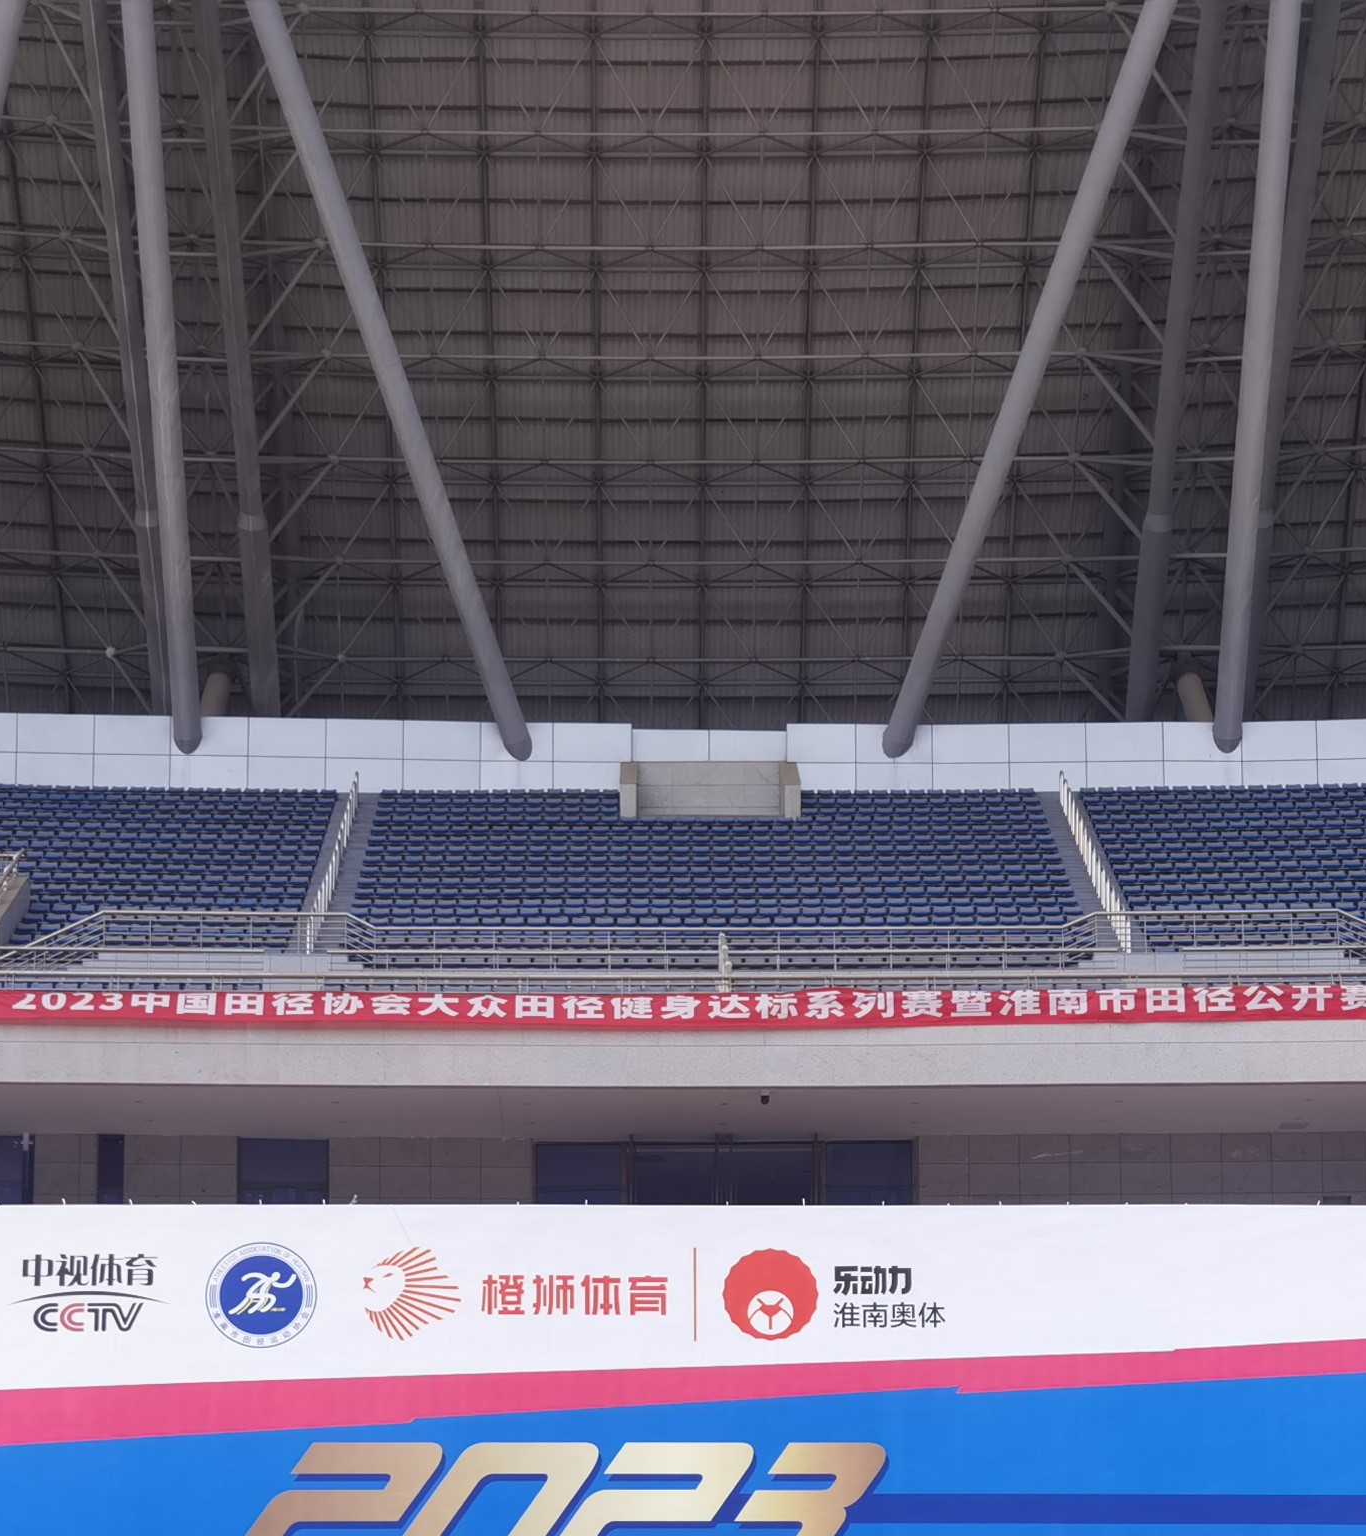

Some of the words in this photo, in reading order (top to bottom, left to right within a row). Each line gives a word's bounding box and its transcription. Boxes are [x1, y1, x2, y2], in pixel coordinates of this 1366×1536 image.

[21, 1253, 159, 1287] 中视体育
[480, 1273, 669, 1316] 橙狮体育
[33, 1302, 144, 1332] CCTV
[833, 1301, 946, 1329] 淮南奥体
